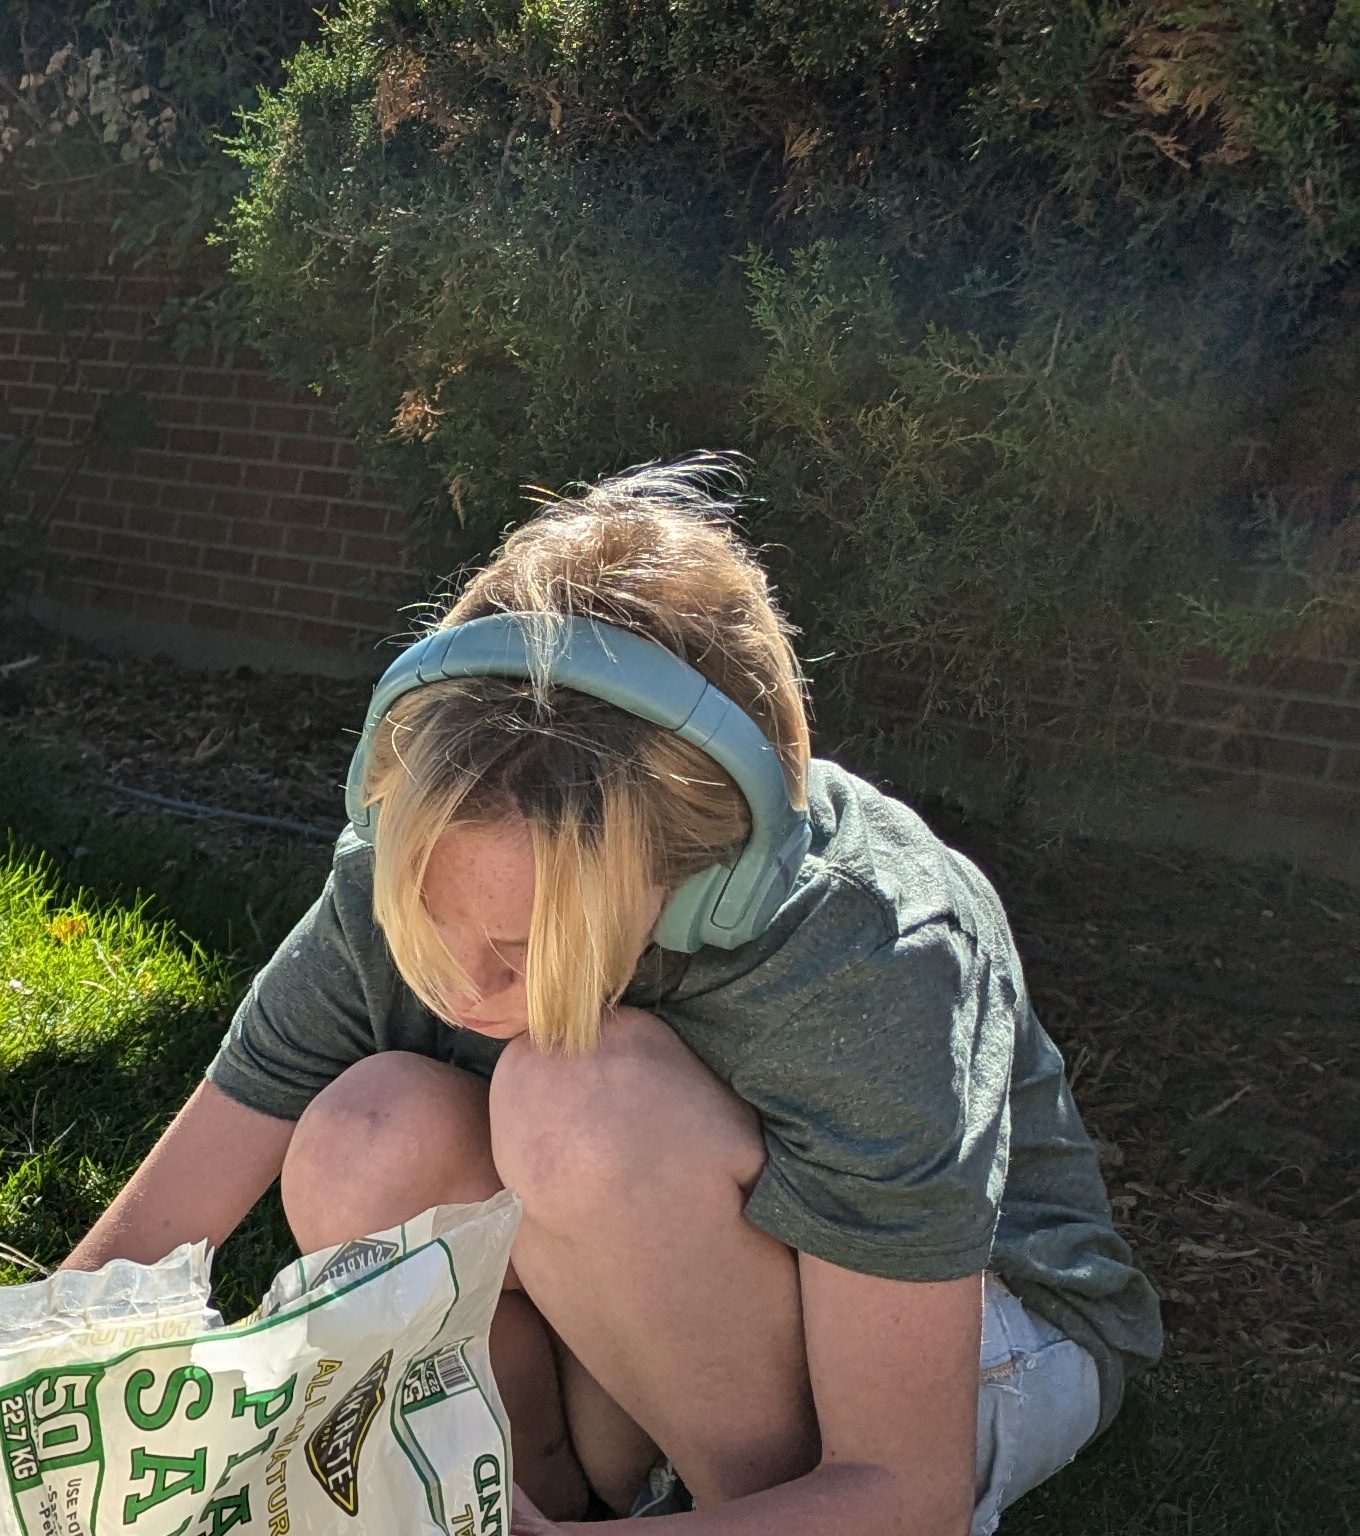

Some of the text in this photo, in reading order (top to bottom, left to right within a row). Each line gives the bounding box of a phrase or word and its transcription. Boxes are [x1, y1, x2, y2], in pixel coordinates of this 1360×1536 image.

[1, 1396, 28, 1442] 22.7
[34, 1374, 95, 1463] 50
[327, 1368, 384, 1490] SAKRETE
[9, 1443, 38, 1481] KG
[66, 1478, 82, 1509] USE
